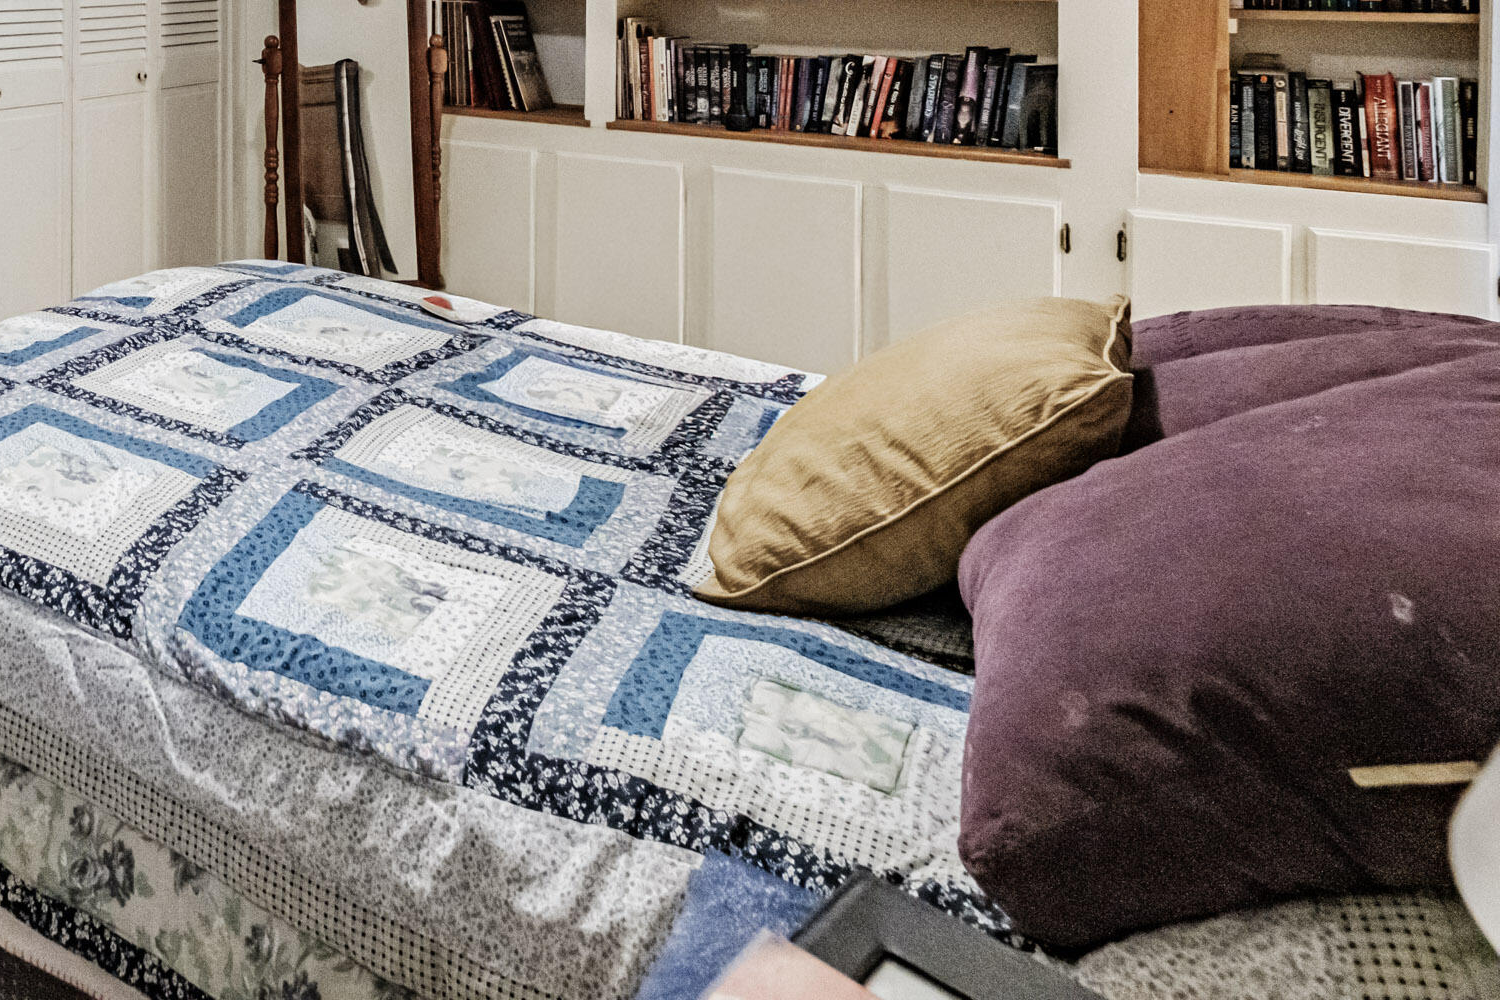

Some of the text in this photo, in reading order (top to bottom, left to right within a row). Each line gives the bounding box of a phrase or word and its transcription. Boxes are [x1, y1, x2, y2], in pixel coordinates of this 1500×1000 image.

[1231, 104, 1239, 123] RAIN
[1314, 103, 1327, 161] INSURGENT
[1338, 106, 1354, 164] DIVERGENT
[1373, 96, 1391, 161] ALLEGIANT
